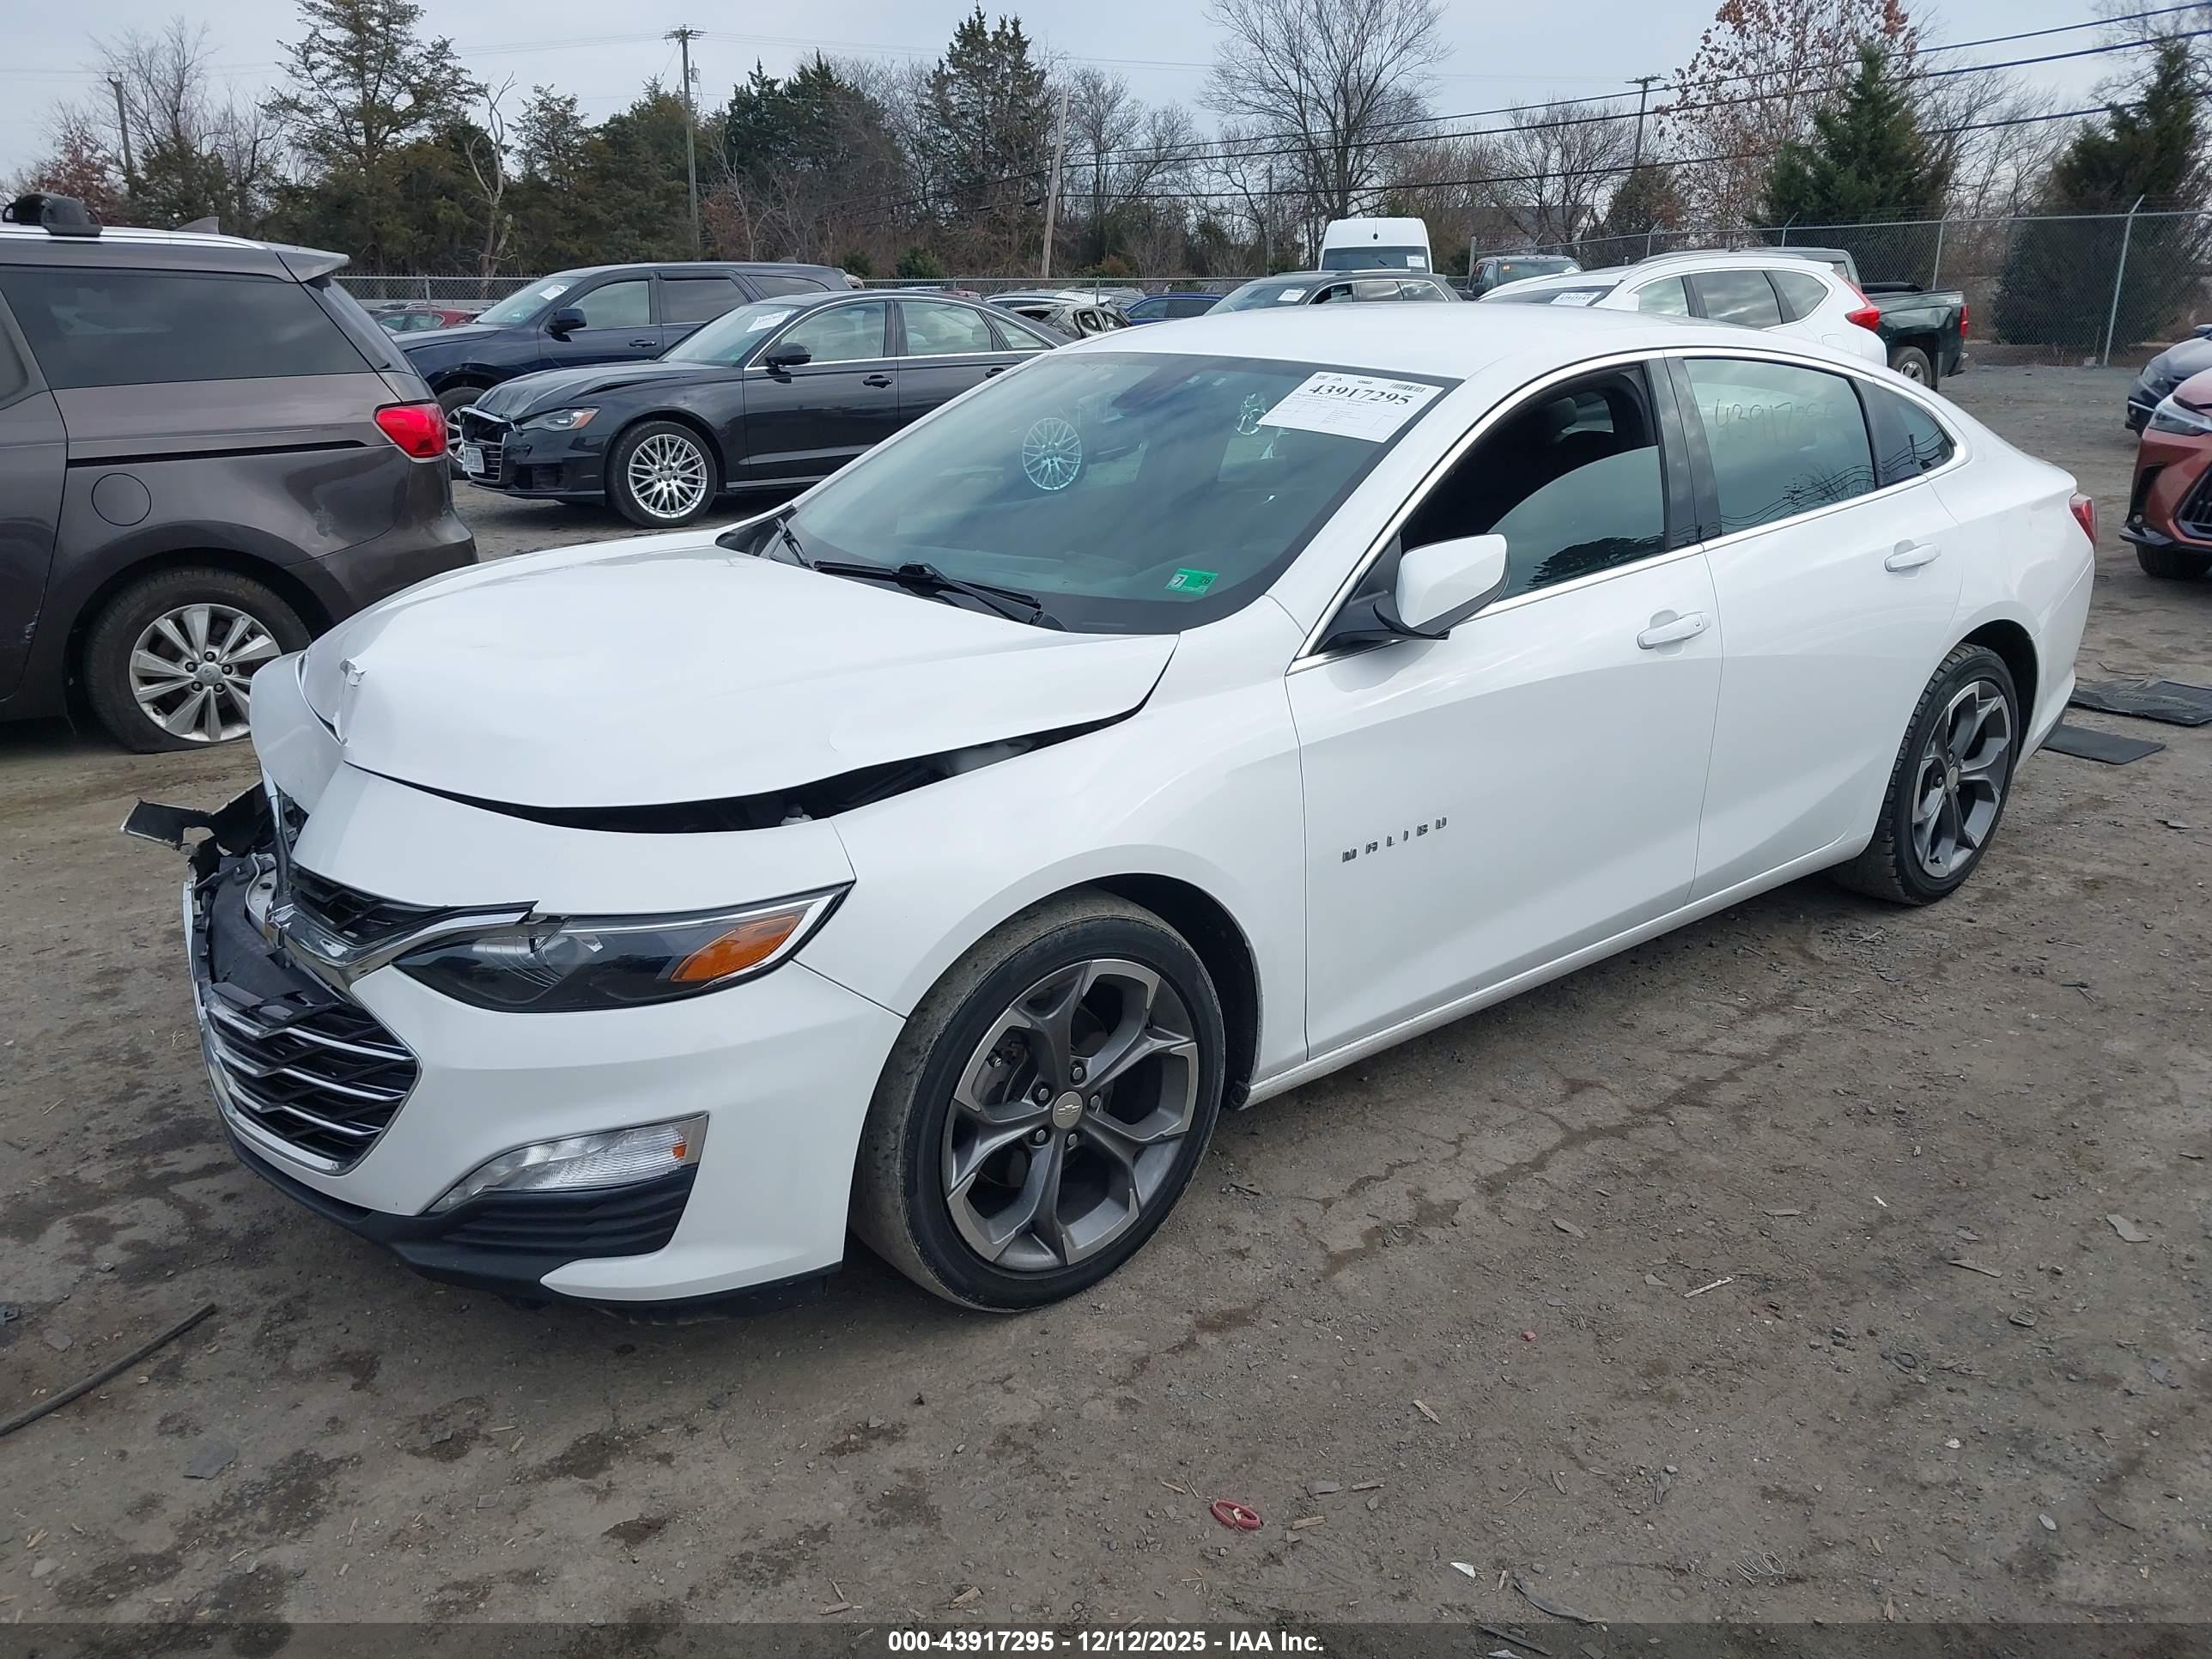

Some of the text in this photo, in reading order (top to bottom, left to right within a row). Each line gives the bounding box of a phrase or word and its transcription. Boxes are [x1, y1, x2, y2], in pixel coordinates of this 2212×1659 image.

[1309, 383, 1414, 405] 43917295
[1174, 575, 1186, 586] 7
[1341, 816, 1448, 863] MALIBU
